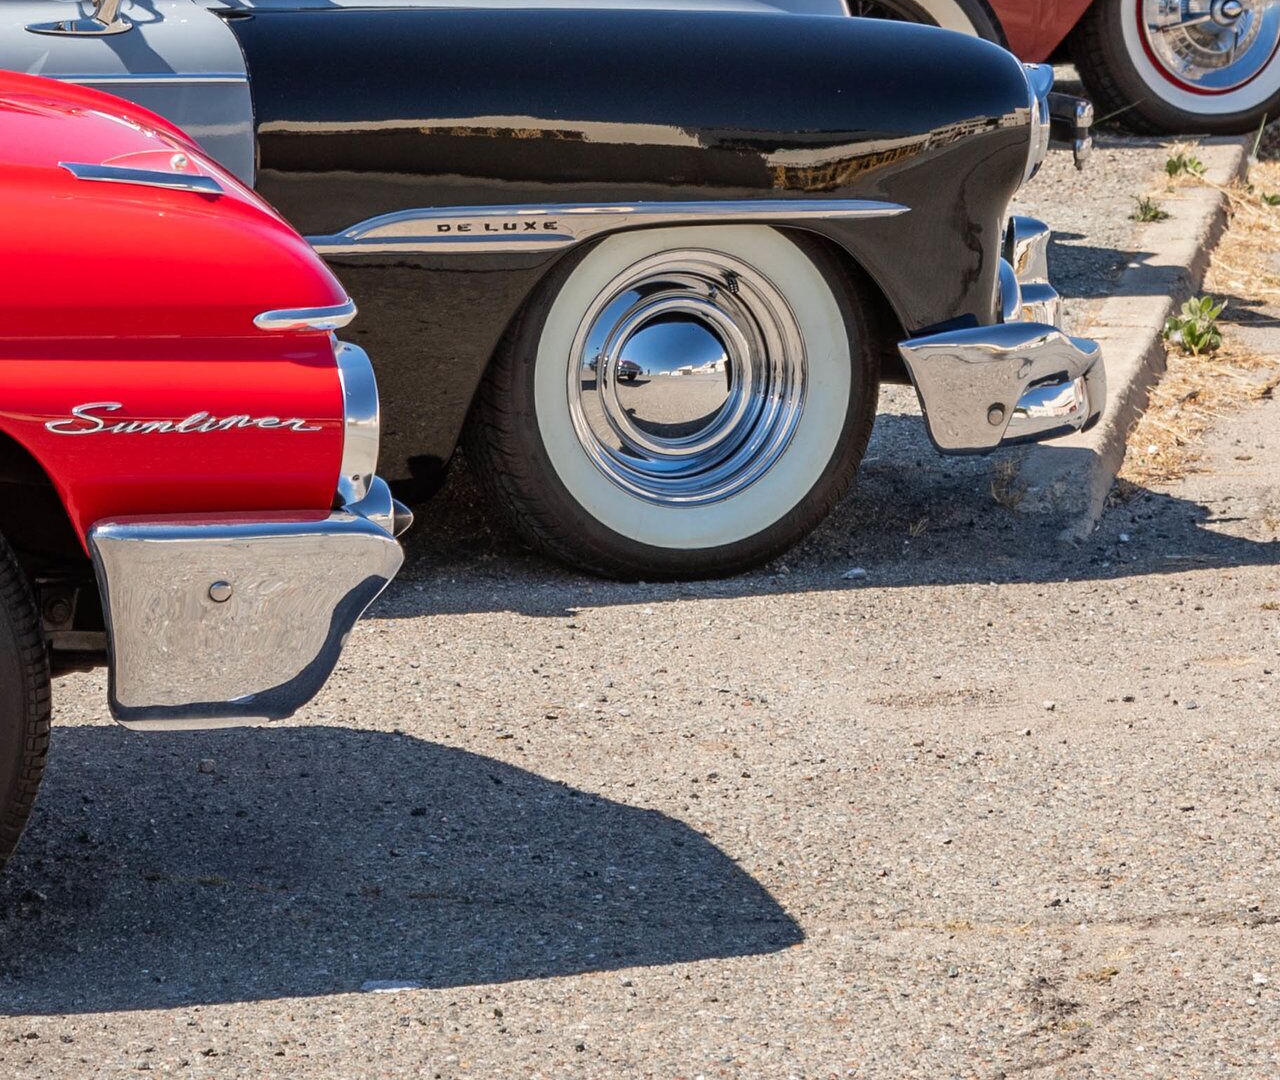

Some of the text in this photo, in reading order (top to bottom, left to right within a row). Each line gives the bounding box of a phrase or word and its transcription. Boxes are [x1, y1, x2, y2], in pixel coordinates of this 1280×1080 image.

[436, 221, 558, 233] DE LUXE
[44, 401, 323, 435] Sunliner
